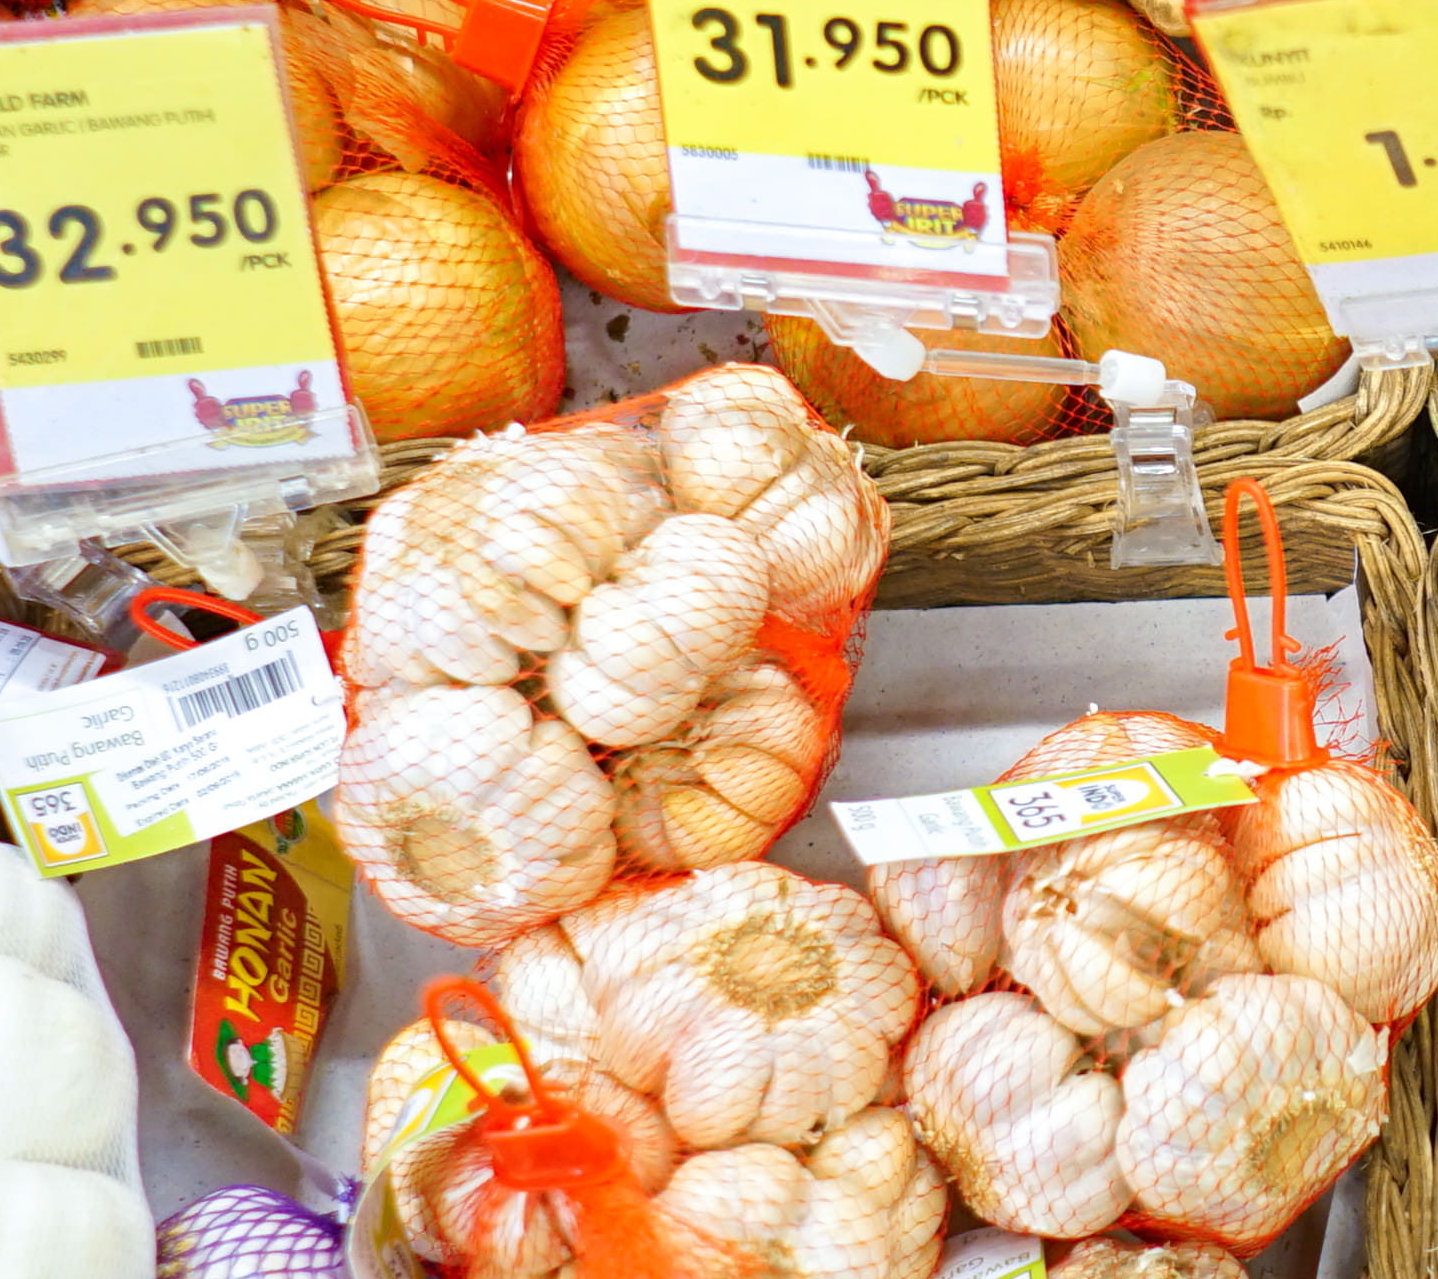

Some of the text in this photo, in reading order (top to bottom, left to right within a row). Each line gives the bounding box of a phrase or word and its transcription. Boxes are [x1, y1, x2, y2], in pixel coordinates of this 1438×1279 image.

[690, 7, 964, 91] 31.950
[29, 90, 90, 110] FARM
[917, 87, 970, 107] /PCK
[239, 252, 292, 272] /PCK
[245, 620, 301, 651] 500 g
[83, 705, 135, 731] Garlic
[25, 743, 70, 768] Putih
[73, 730, 145, 764] Bawang
[32, 790, 75, 816] 365
[1008, 790, 1067, 829] 365
[1076, 784, 1114, 813] INDO
[46, 822, 83, 840] INDO
[213, 863, 238, 981] BAWANG PUTIH
[225, 849, 277, 1020] HONAN
[269, 907, 298, 1004] Garlic
